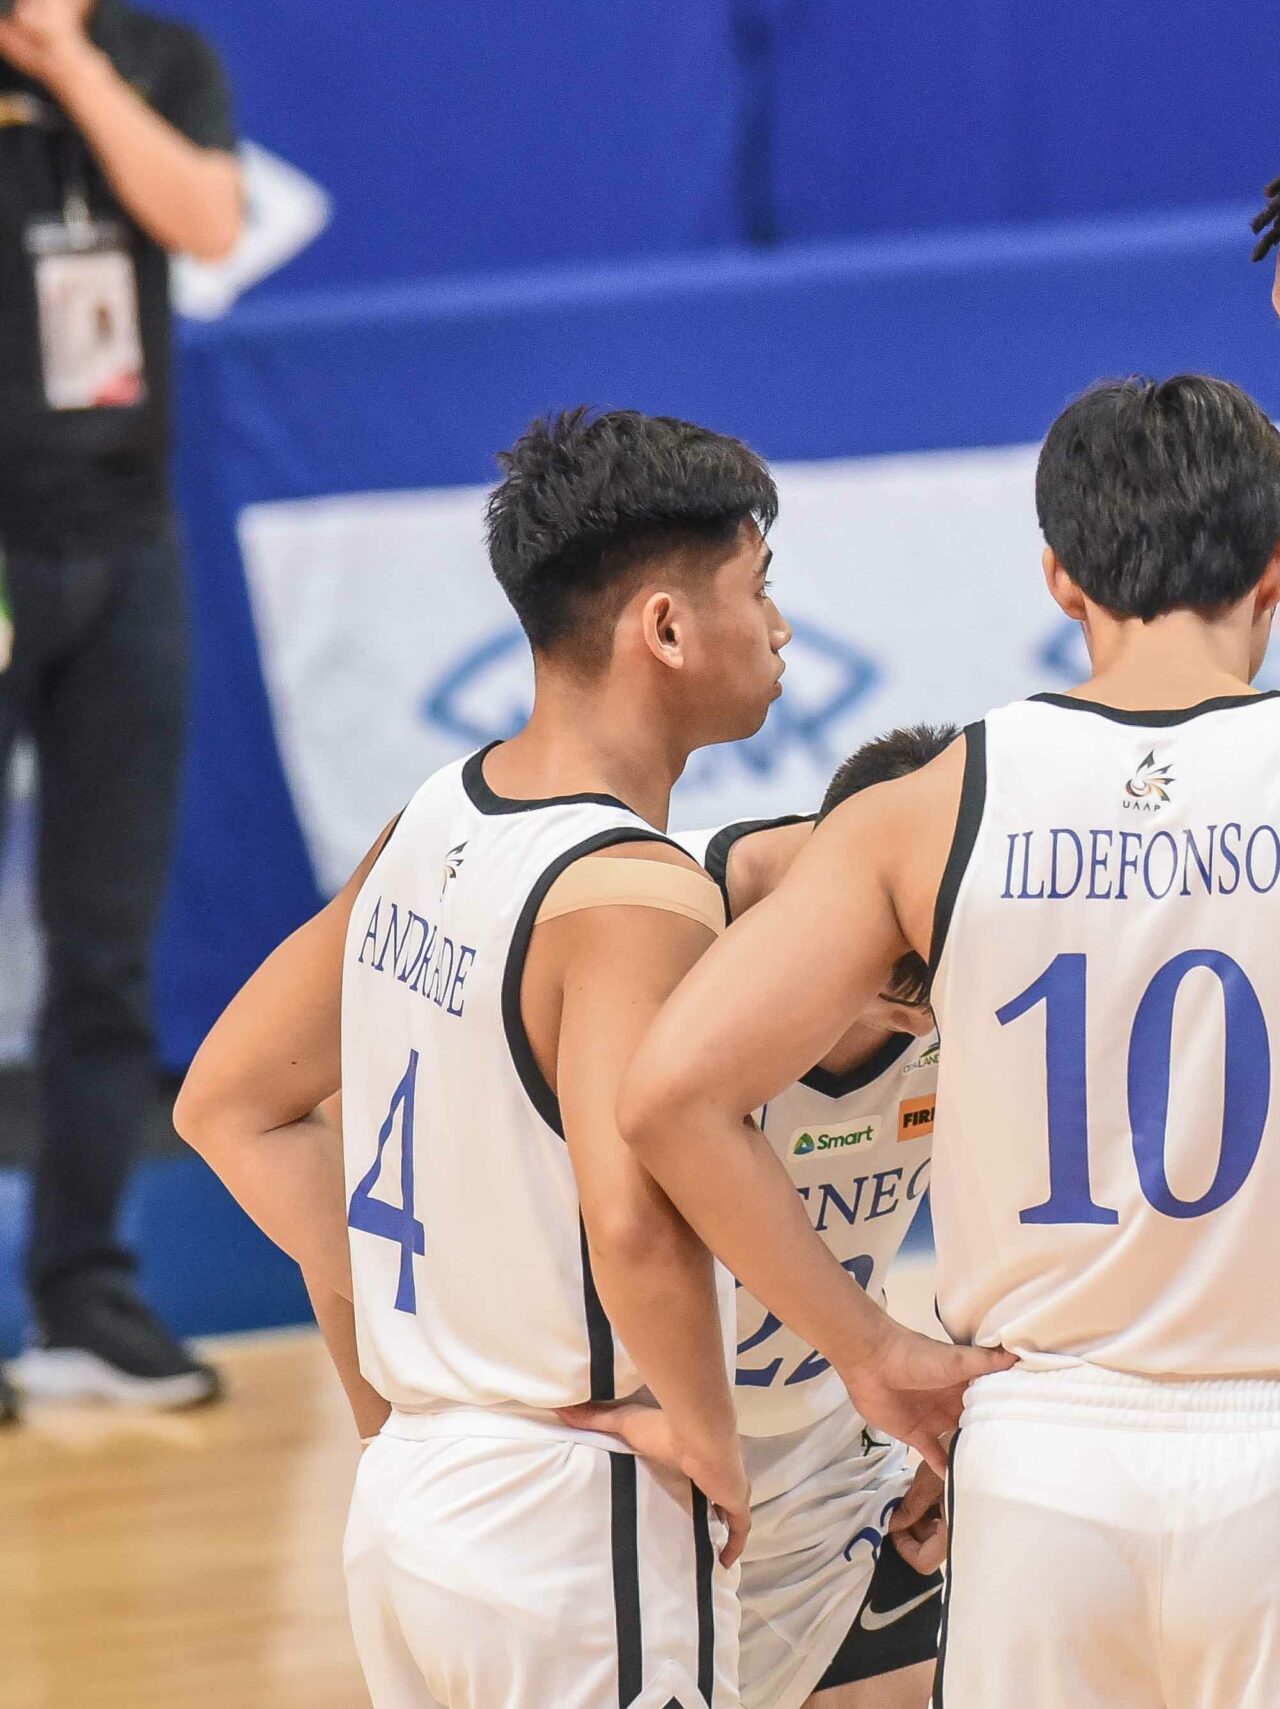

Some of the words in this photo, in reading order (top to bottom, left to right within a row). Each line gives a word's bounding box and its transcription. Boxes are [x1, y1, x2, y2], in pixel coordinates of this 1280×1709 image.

[1122, 800, 1161, 812] UAAP
[358, 896, 477, 1017] ANDRADE
[817, 1125, 874, 1150] Smart
[995, 948, 1272, 1225] 10
[348, 1048, 426, 1316] 4
